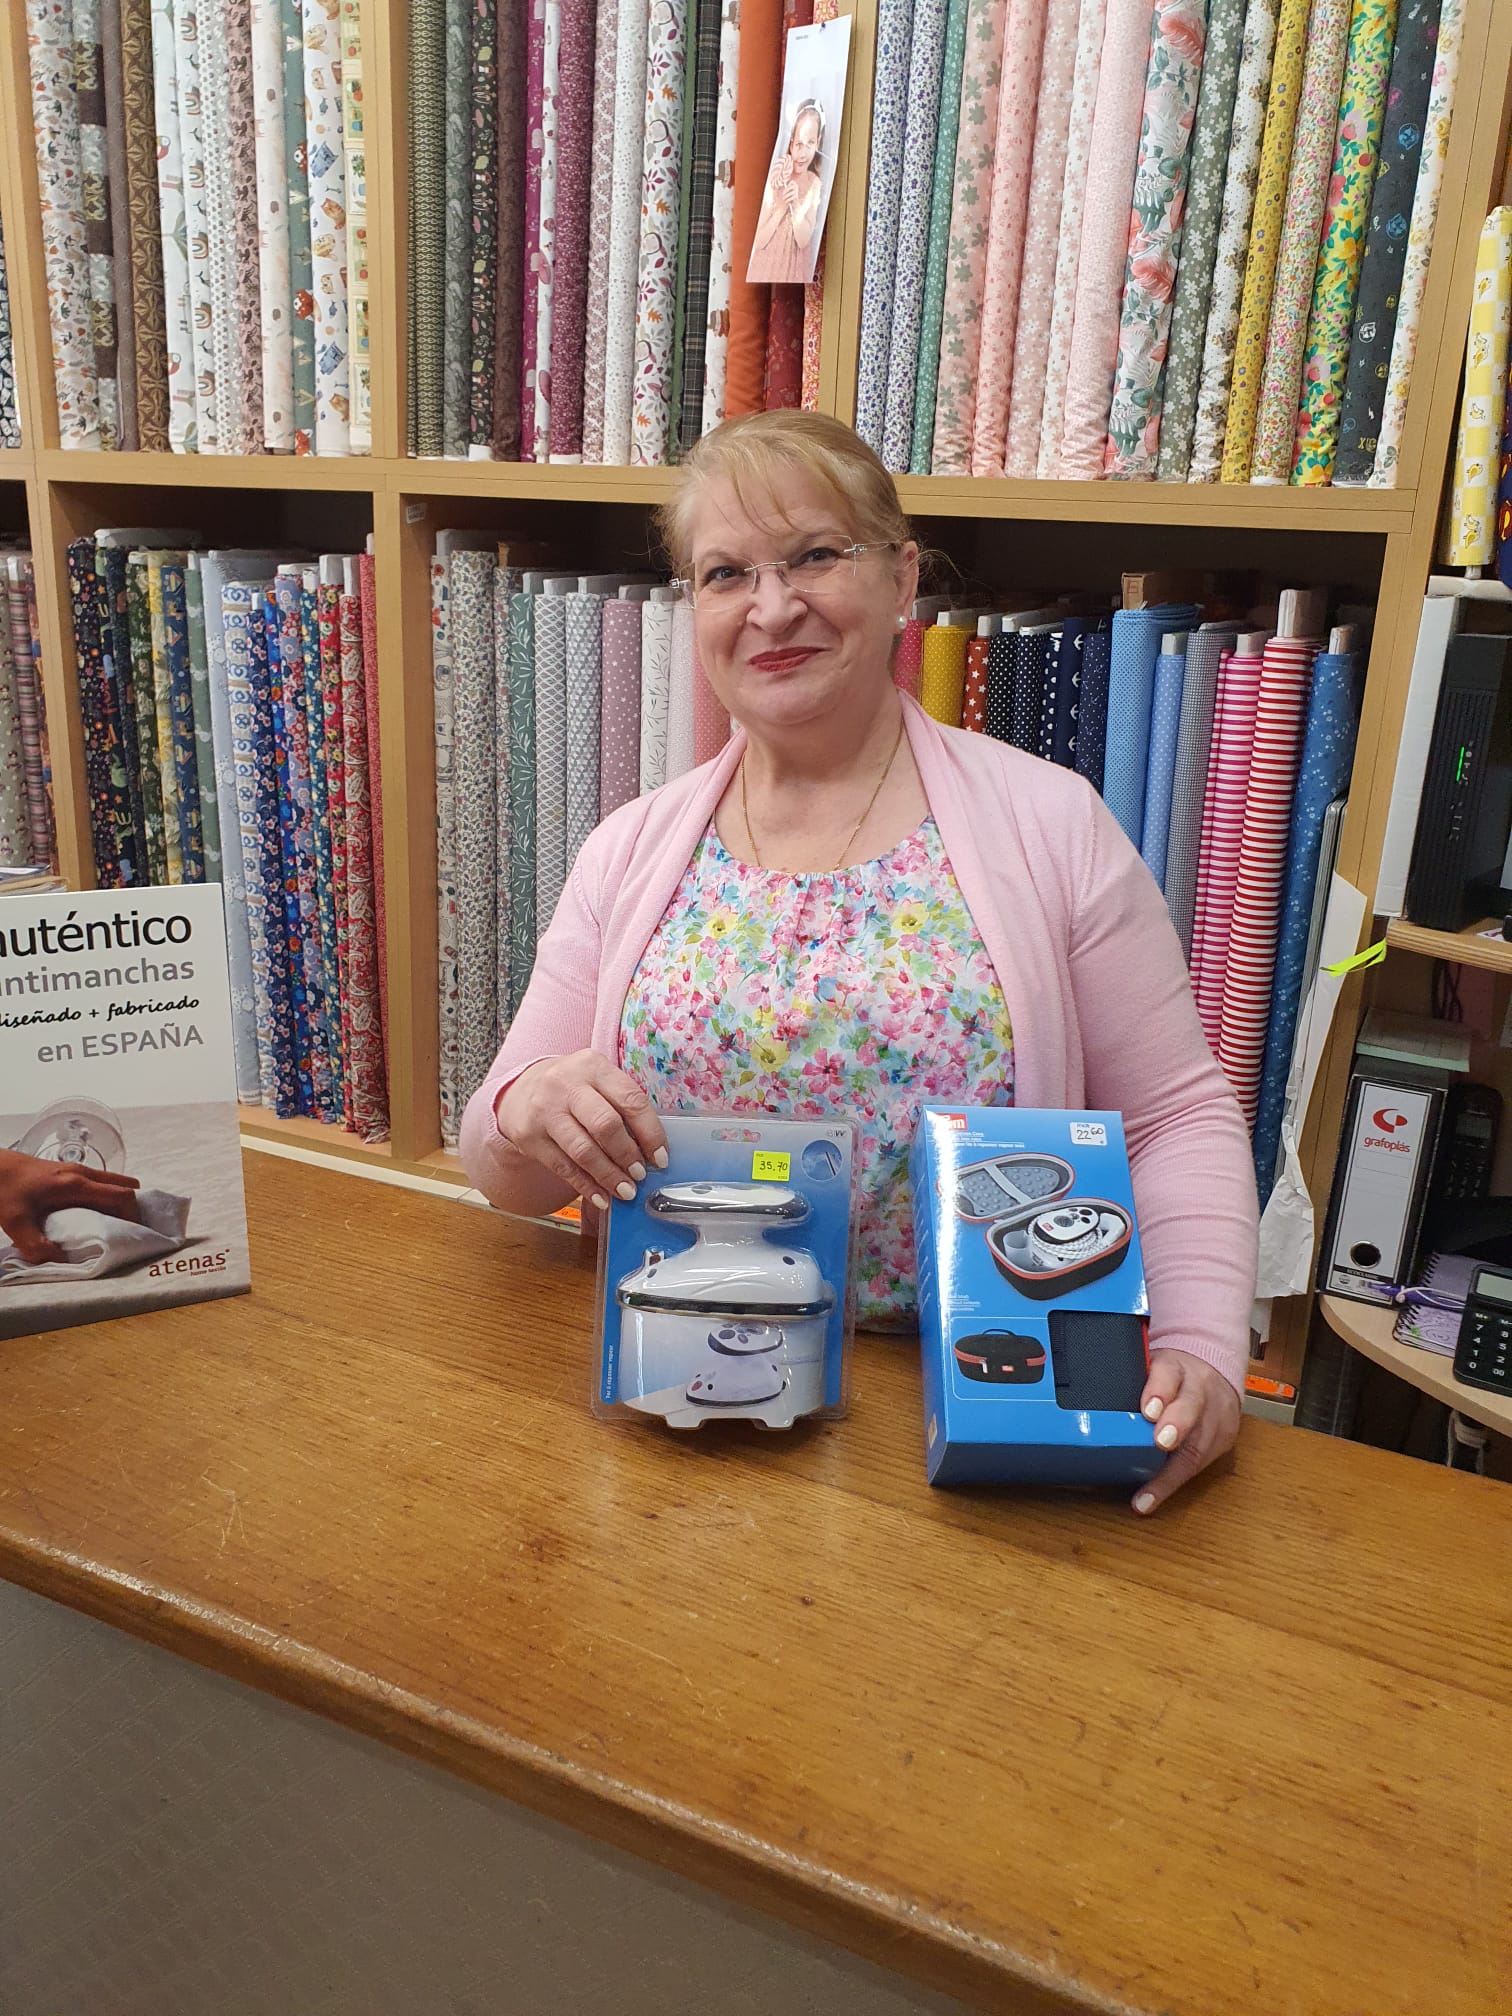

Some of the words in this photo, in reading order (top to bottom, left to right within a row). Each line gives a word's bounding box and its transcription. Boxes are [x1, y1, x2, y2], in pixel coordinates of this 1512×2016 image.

[0, 911, 192, 957] uténtico
[0, 958, 195, 997] ntimanchas
[0, 1007, 82, 1028] iseñado
[107, 995, 200, 1021] fabricado
[37, 1043, 73, 1063] en
[82, 1022, 204, 1058] ESPAÑA
[1363, 1137, 1411, 1152] grafoplás
[760, 1160, 788, 1172] 35.70
[149, 1252, 226, 1277] atenas
[1475, 1323, 1484, 1331] 7
[1501, 1330, 1509, 1339] 8
[1473, 1336, 1481, 1344] 4
[1498, 1342, 1507, 1351] 5
[1473, 1349, 1479, 1357] 1
[1496, 1355, 1505, 1364] 2
[1469, 1361, 1477, 1369] 0
[1493, 1367, 1505, 1377] 00
